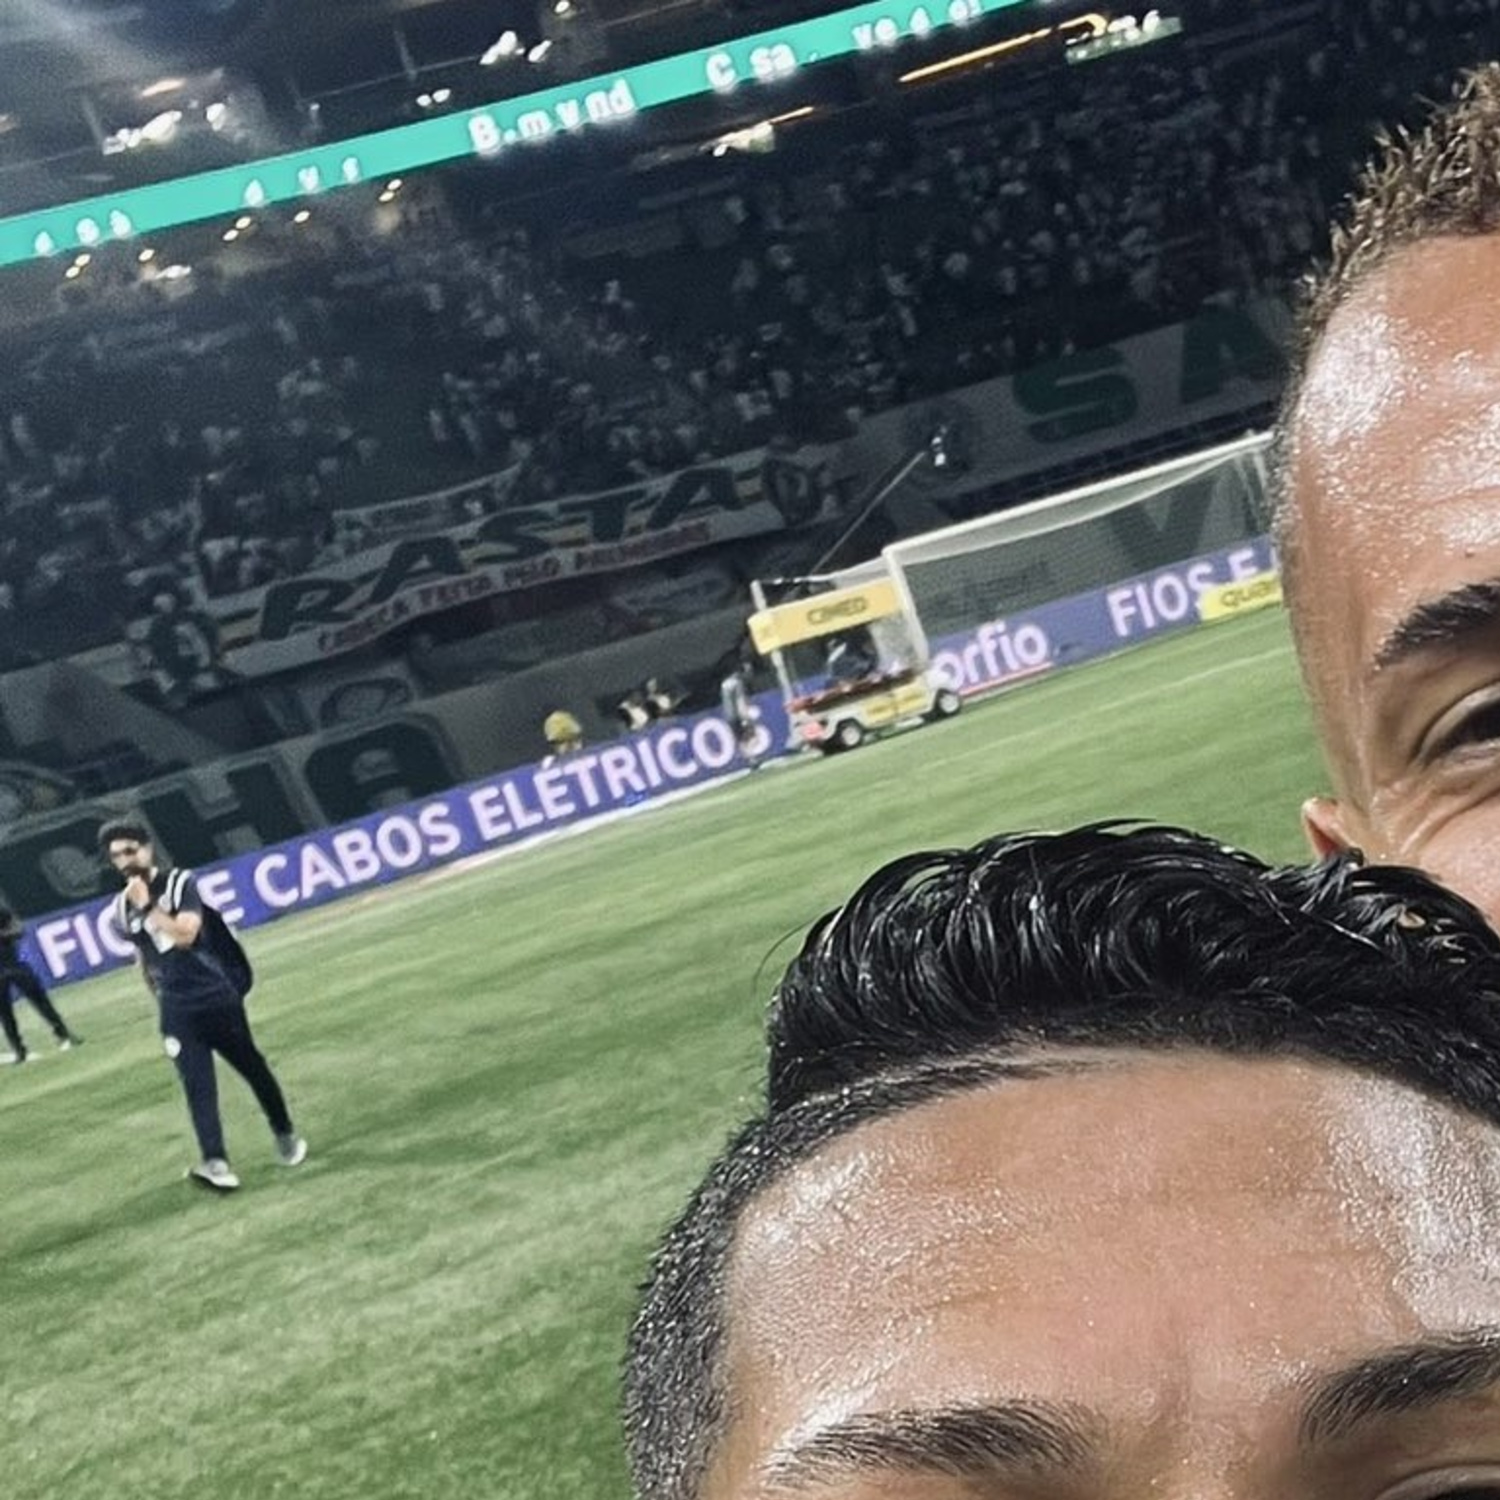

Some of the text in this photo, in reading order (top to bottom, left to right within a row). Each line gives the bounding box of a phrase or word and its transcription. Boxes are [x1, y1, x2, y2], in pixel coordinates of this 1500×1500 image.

[931, 618, 1048, 689] orfio
[36, 891, 137, 979] FIO
[253, 801, 462, 907] CABOS
[468, 706, 772, 842] ELÉTRICOS
